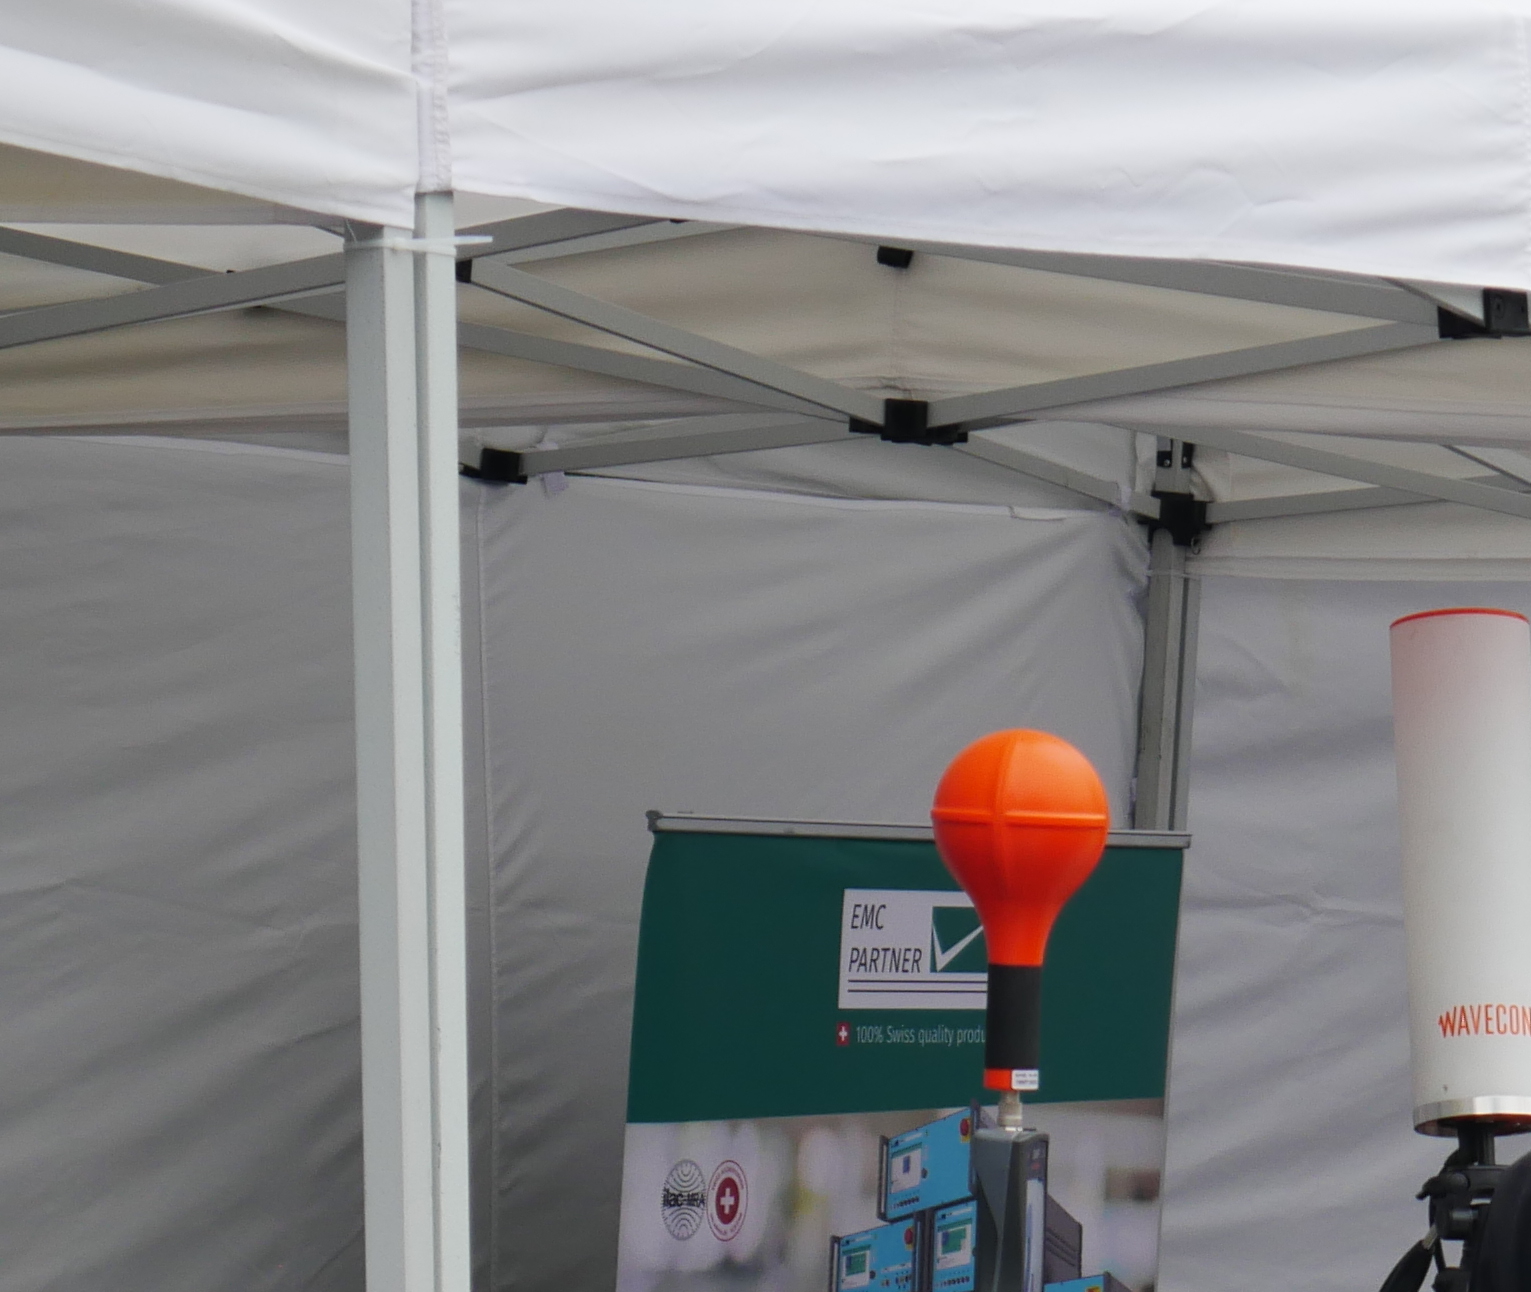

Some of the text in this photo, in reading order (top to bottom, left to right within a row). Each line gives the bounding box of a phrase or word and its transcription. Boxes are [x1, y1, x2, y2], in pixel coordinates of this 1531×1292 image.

[850, 904, 887, 930] EMC
[849, 947, 923, 973] PARTNER
[856, 1025, 884, 1044] 100%
[886, 1025, 915, 1044] Swiss
[918, 1024, 954, 1047] quality
